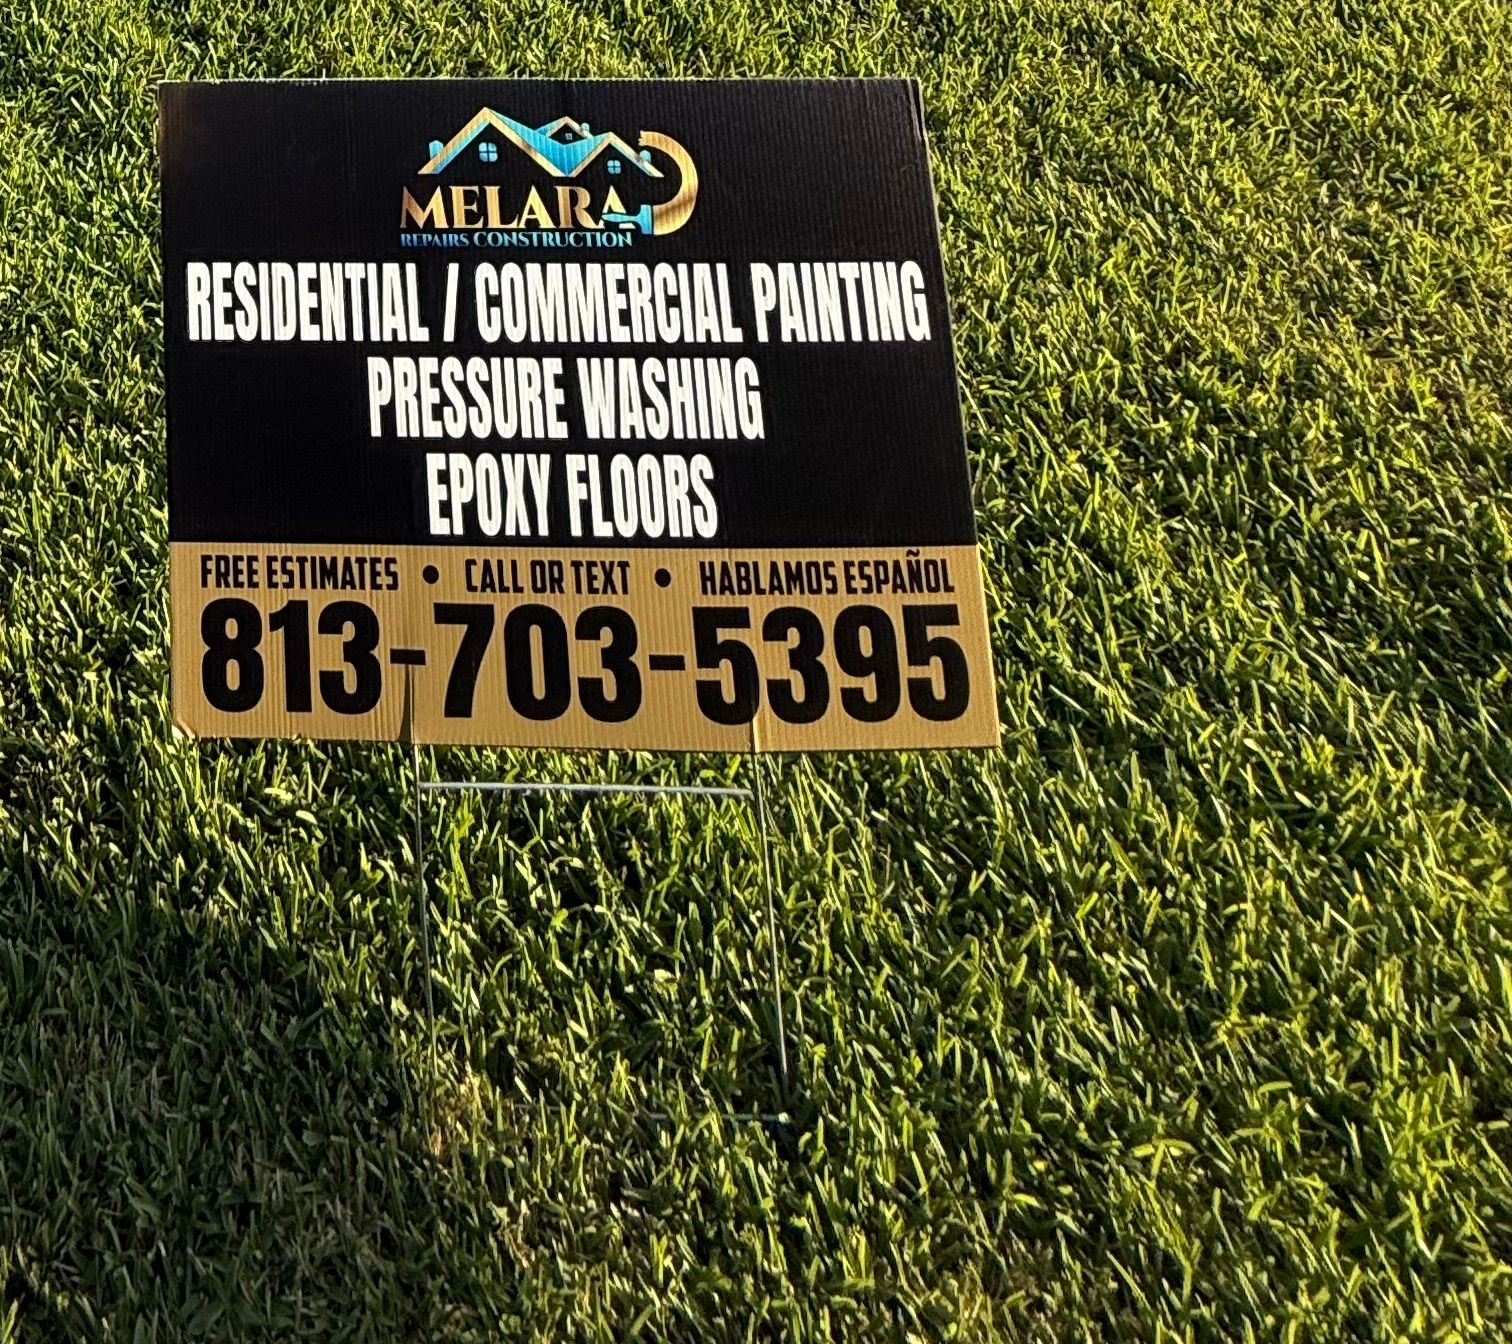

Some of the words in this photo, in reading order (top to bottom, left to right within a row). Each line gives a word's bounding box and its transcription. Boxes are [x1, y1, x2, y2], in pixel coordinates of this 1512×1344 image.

[399, 185, 637, 230] MELARA
[400, 232, 470, 249] REPAIRS
[473, 231, 633, 249] CONSTRUCTION
[186, 261, 430, 343] RESIDENTIAL
[474, 261, 744, 344] COMMERCIAL
[750, 260, 932, 343] PAINTING
[366, 356, 569, 440] PRESSURE
[576, 356, 766, 440] WASHING
[425, 452, 551, 537] EPOXY
[565, 453, 719, 539] FLOORS
[200, 554, 260, 589] FREE
[266, 555, 399, 591] ESTIMATES
[464, 558, 524, 594] CALL
[530, 559, 566, 595] OR
[571, 559, 630, 595] TEXT
[699, 559, 838, 596] HABLAMOS
[843, 548, 956, 595] ESPAÑOL
[200, 597, 971, 726] 813-703-5395
